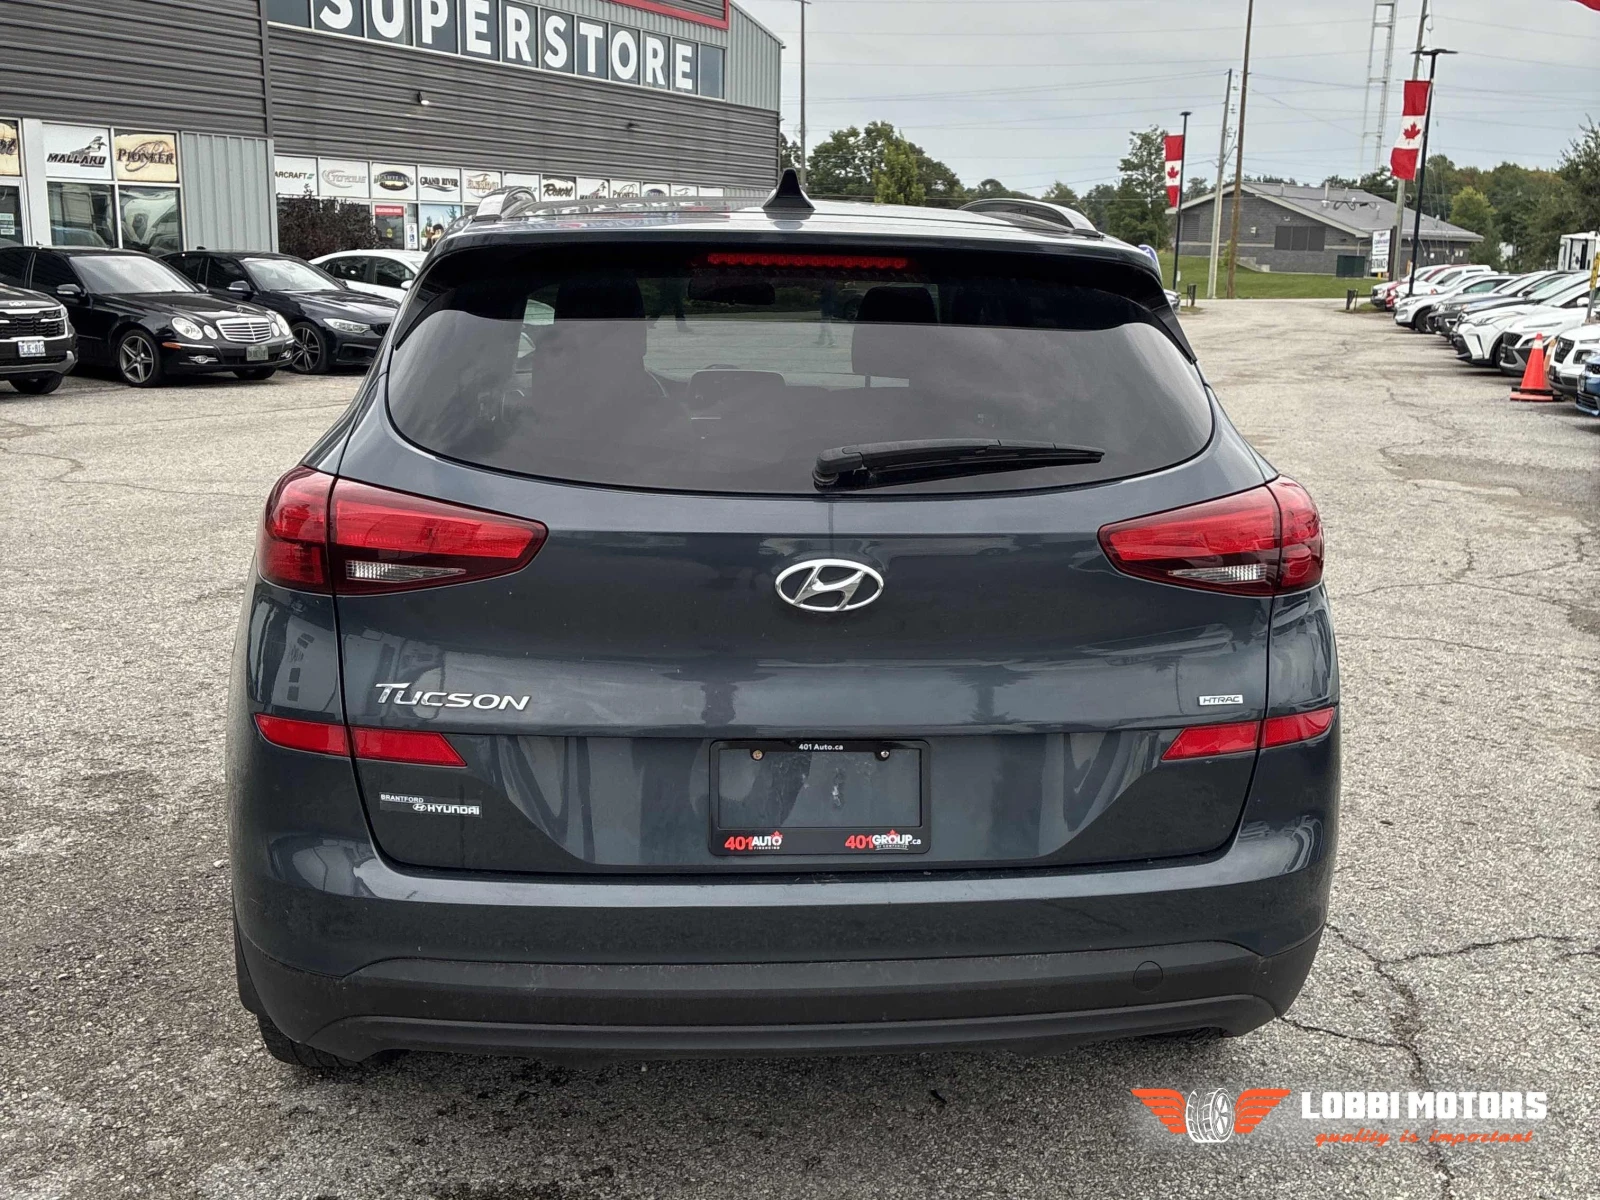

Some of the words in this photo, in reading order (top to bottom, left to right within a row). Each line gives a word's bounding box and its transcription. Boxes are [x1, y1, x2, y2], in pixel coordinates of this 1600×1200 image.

[318, 0, 695, 90] SUPERSTORE
[47, 152, 107, 167] MALLARD
[117, 148, 175, 165] PIONEER
[275, 171, 307, 179] ARCRAFT
[420, 177, 440, 186] GRAND
[442, 178, 458, 187] RIVER
[543, 183, 574, 198] Resort
[375, 682, 531, 711] TUCSON
[1203, 696, 1240, 704] HTRAC
[798, 743, 812, 751] 401
[813, 743, 844, 751] Auto.ca
[380, 793, 424, 804] BRANTFORD
[427, 803, 480, 815] HYUNDAI
